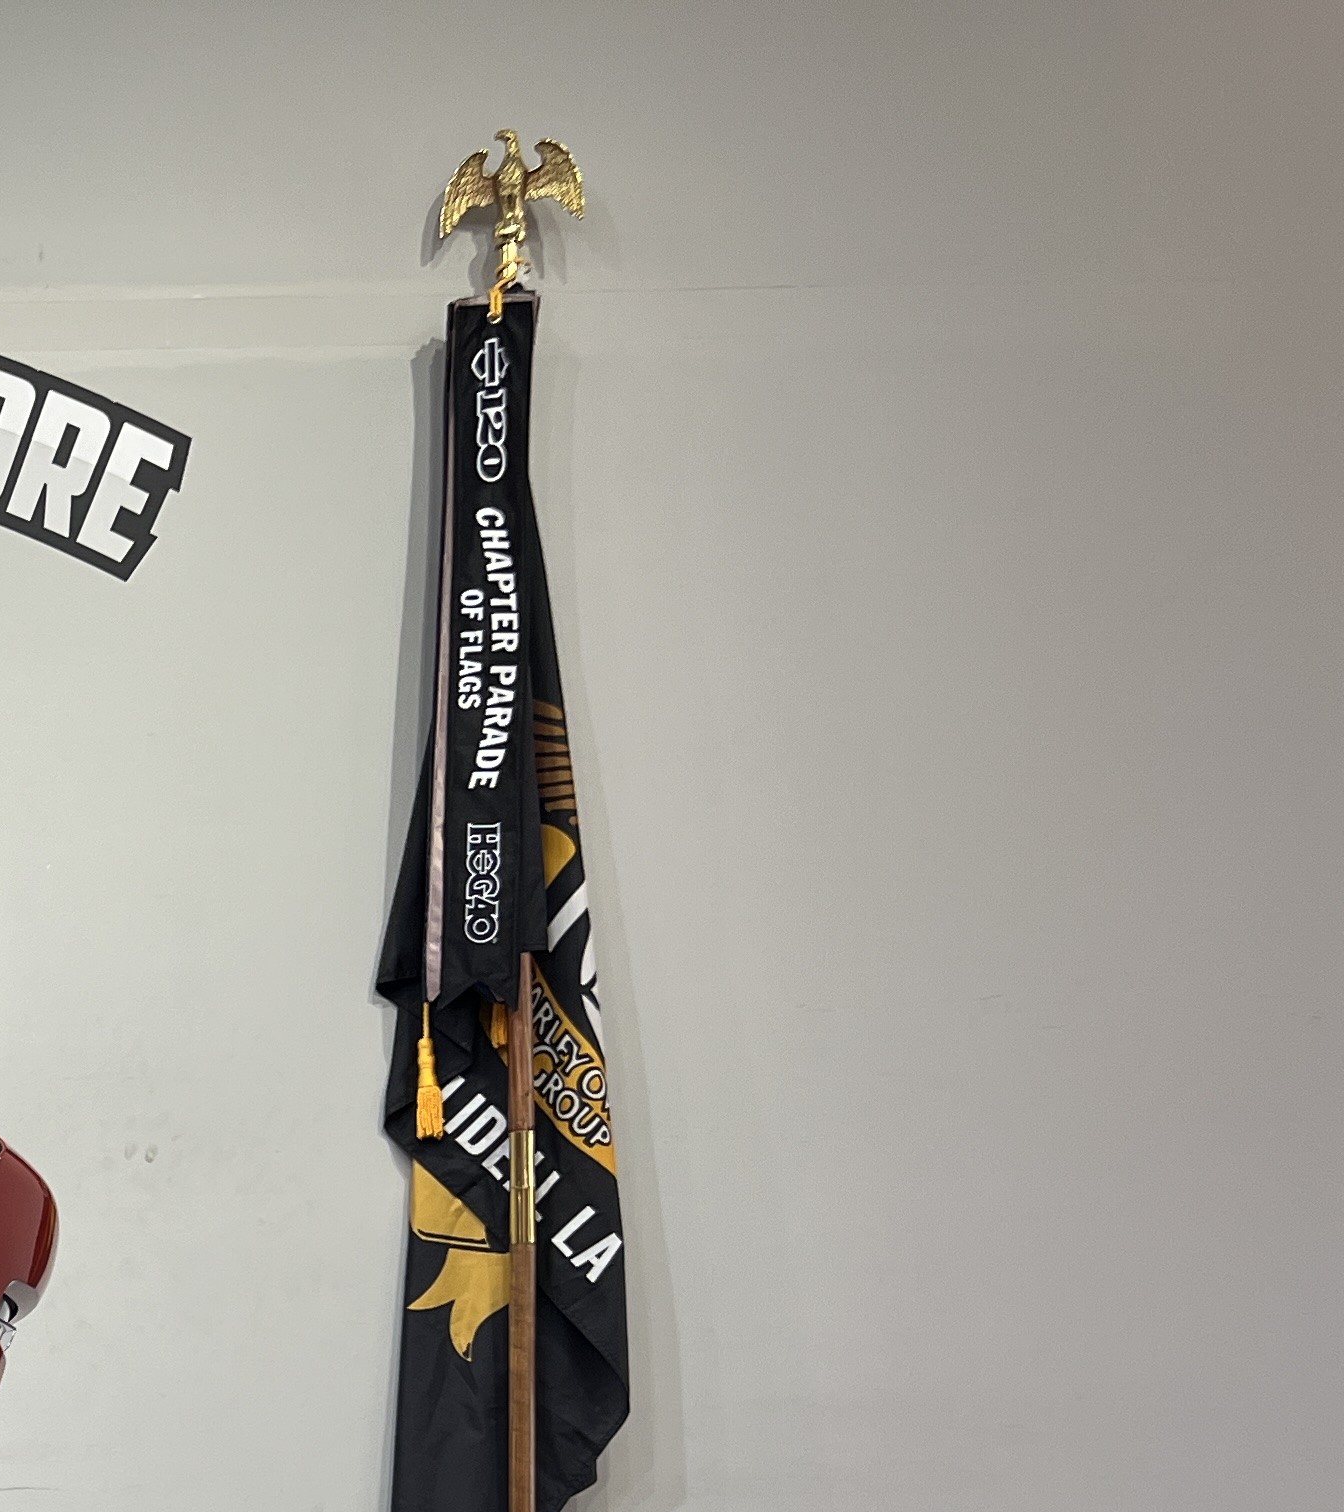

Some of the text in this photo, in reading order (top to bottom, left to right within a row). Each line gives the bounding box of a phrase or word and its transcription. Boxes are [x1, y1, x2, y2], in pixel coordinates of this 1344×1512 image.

[475, 388, 508, 483] 120
[457, 588, 484, 710] OF FLAGS
[467, 507, 520, 791] CHAPTER PARADE
[531, 983, 595, 1078] ARLEY
[532, 1043, 613, 1149] GROUP
[550, 1203, 623, 1284] LA
